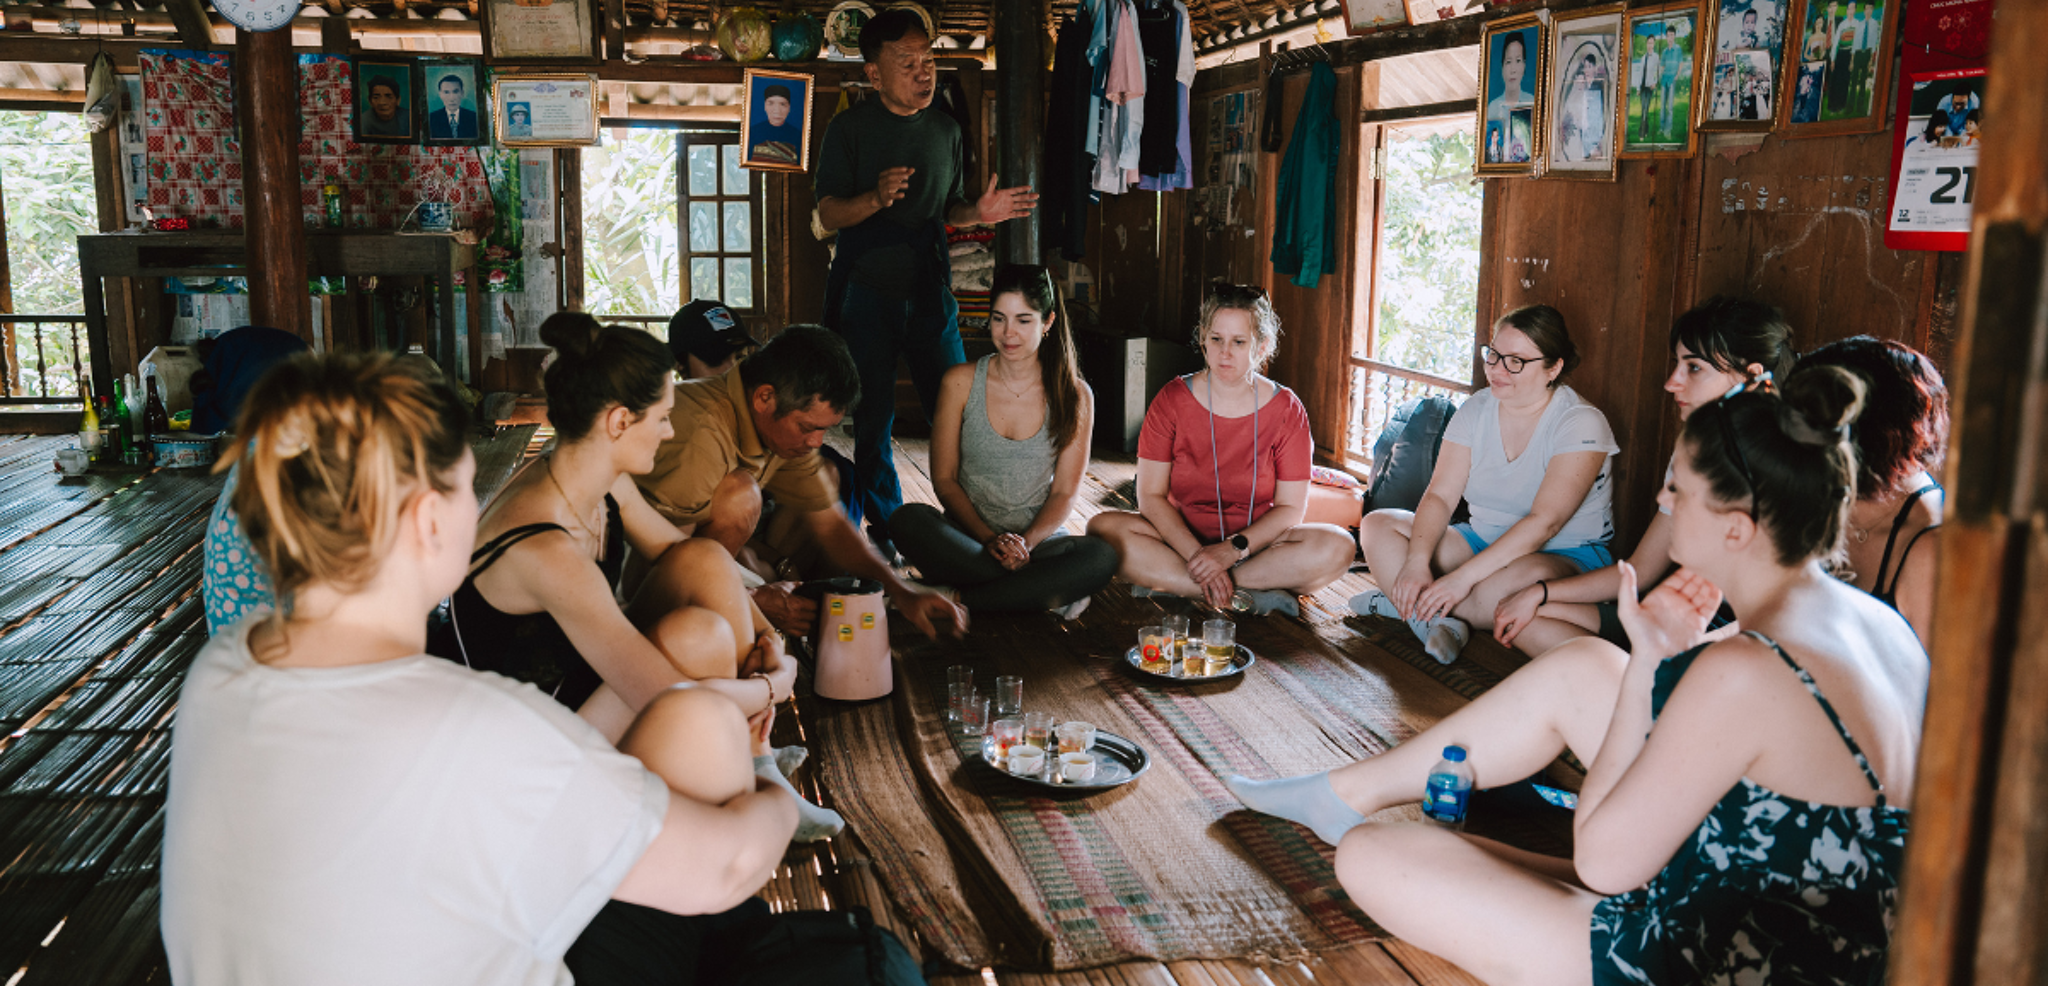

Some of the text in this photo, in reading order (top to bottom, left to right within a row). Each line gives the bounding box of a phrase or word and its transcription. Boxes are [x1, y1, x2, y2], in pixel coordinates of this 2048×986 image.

[231, 3, 239, 12] 7
[276, 4, 285, 13] 4
[245, 11, 255, 21] 6
[263, 11, 272, 21] 5
[1930, 167, 1977, 204] 21
[1899, 209, 1909, 217] 12
